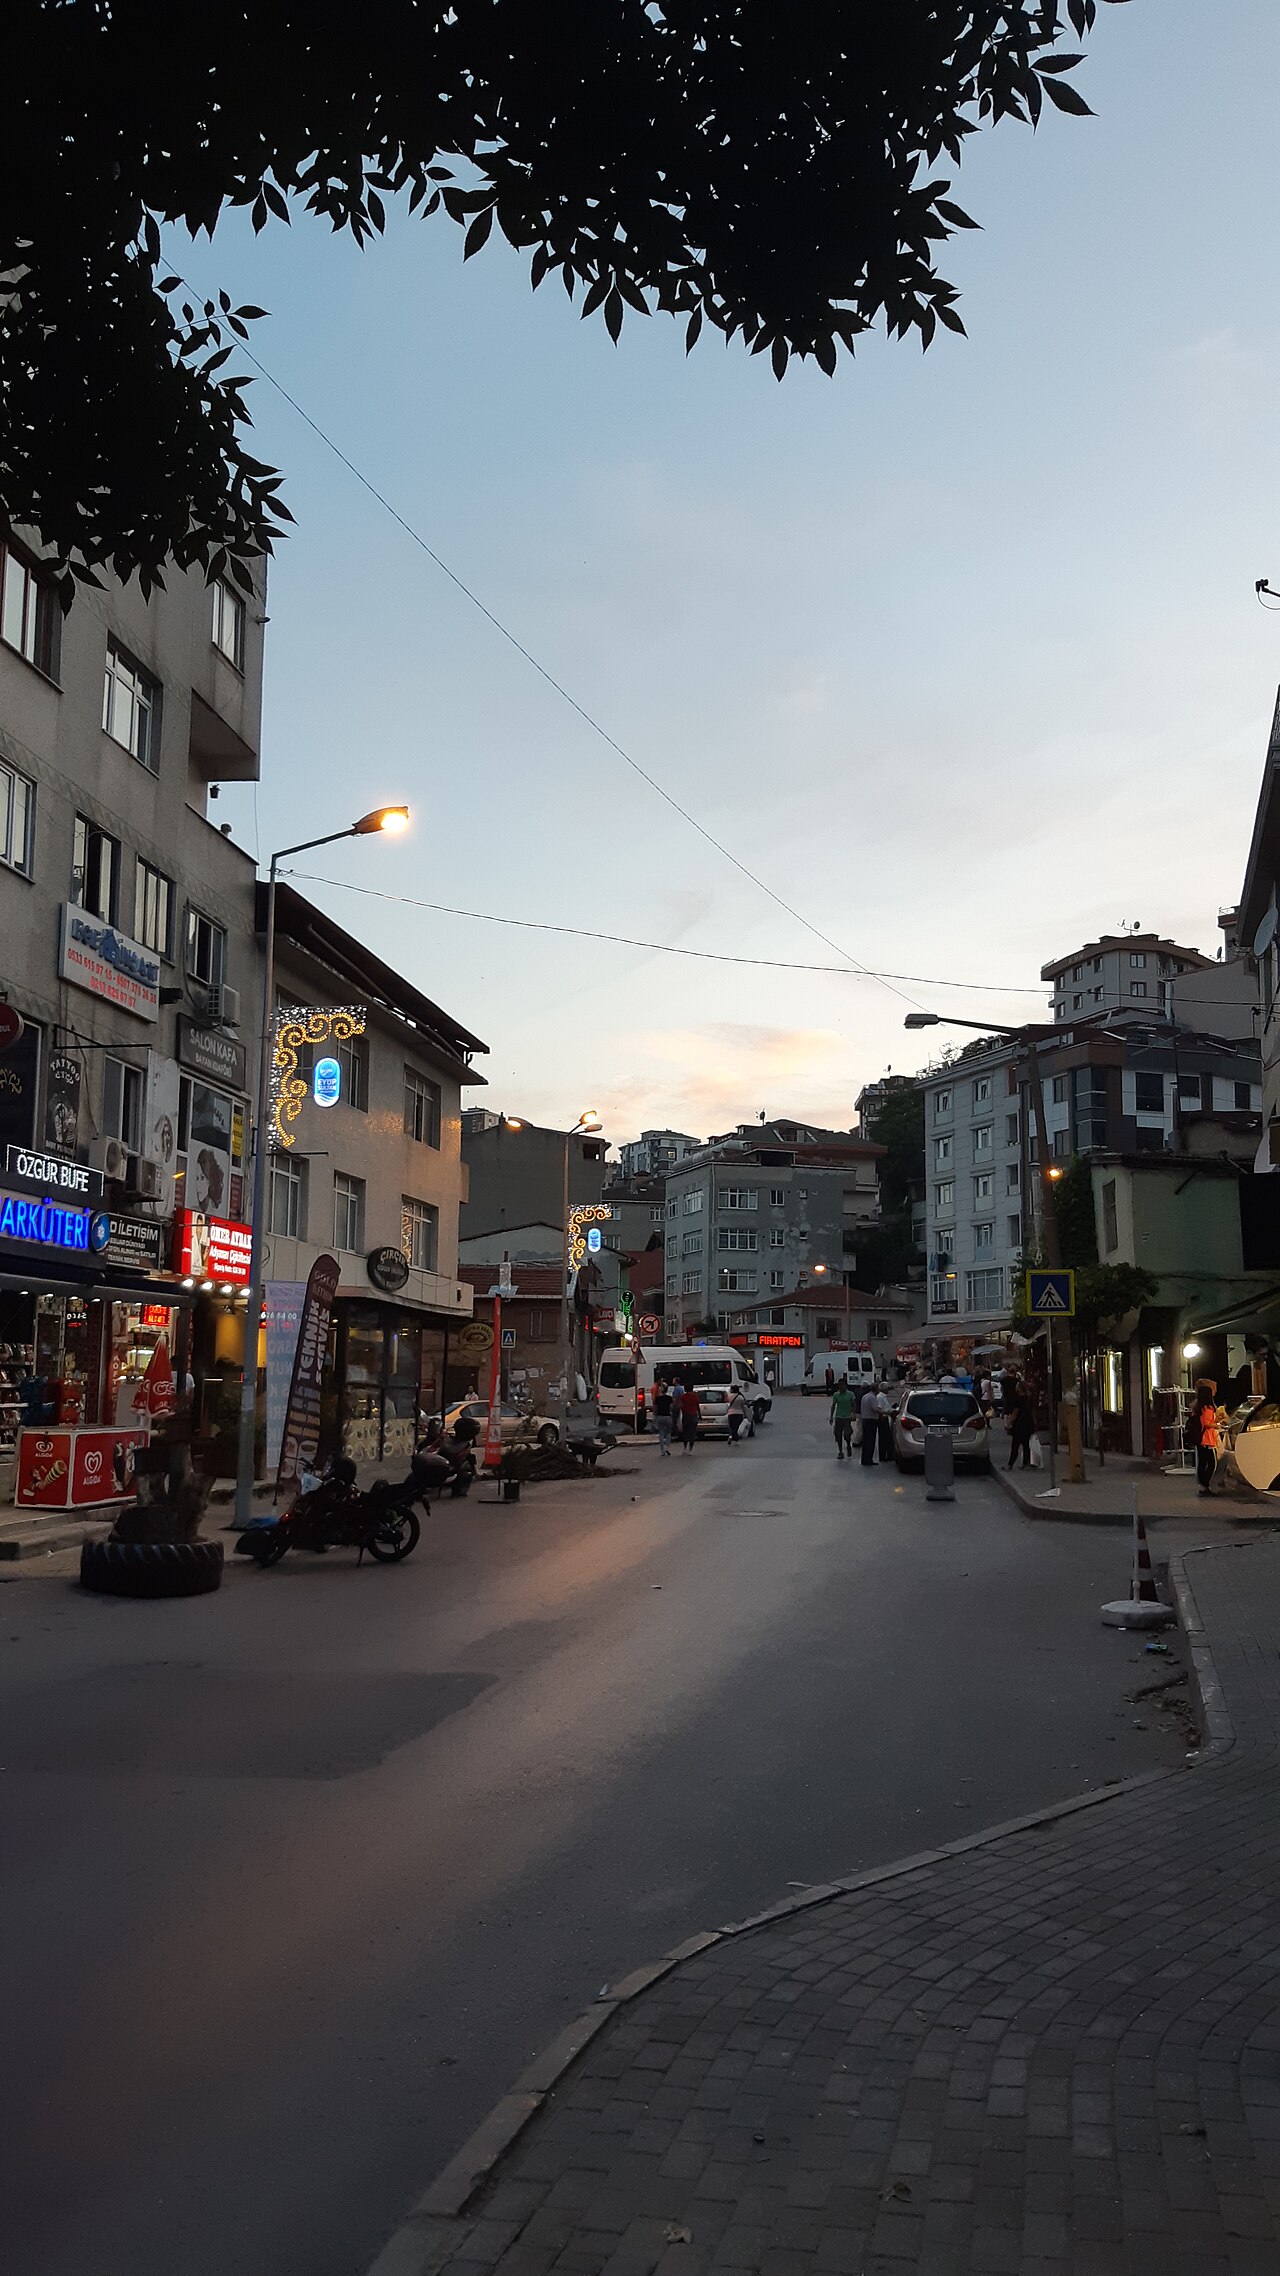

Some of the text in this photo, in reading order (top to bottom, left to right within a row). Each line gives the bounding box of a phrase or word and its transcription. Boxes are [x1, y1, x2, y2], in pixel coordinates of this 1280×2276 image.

[190, 1028, 216, 1055] SALON
[50, 1058, 80, 1081] TATTOO
[17, 1148, 90, 1192] ÖZGÜR BÜFE
[0, 1195, 90, 1250] ARKÜTERİ
[118, 1219, 158, 1242] İLETİŞİM
[758, 1335, 801, 1346] FIRATPEN
